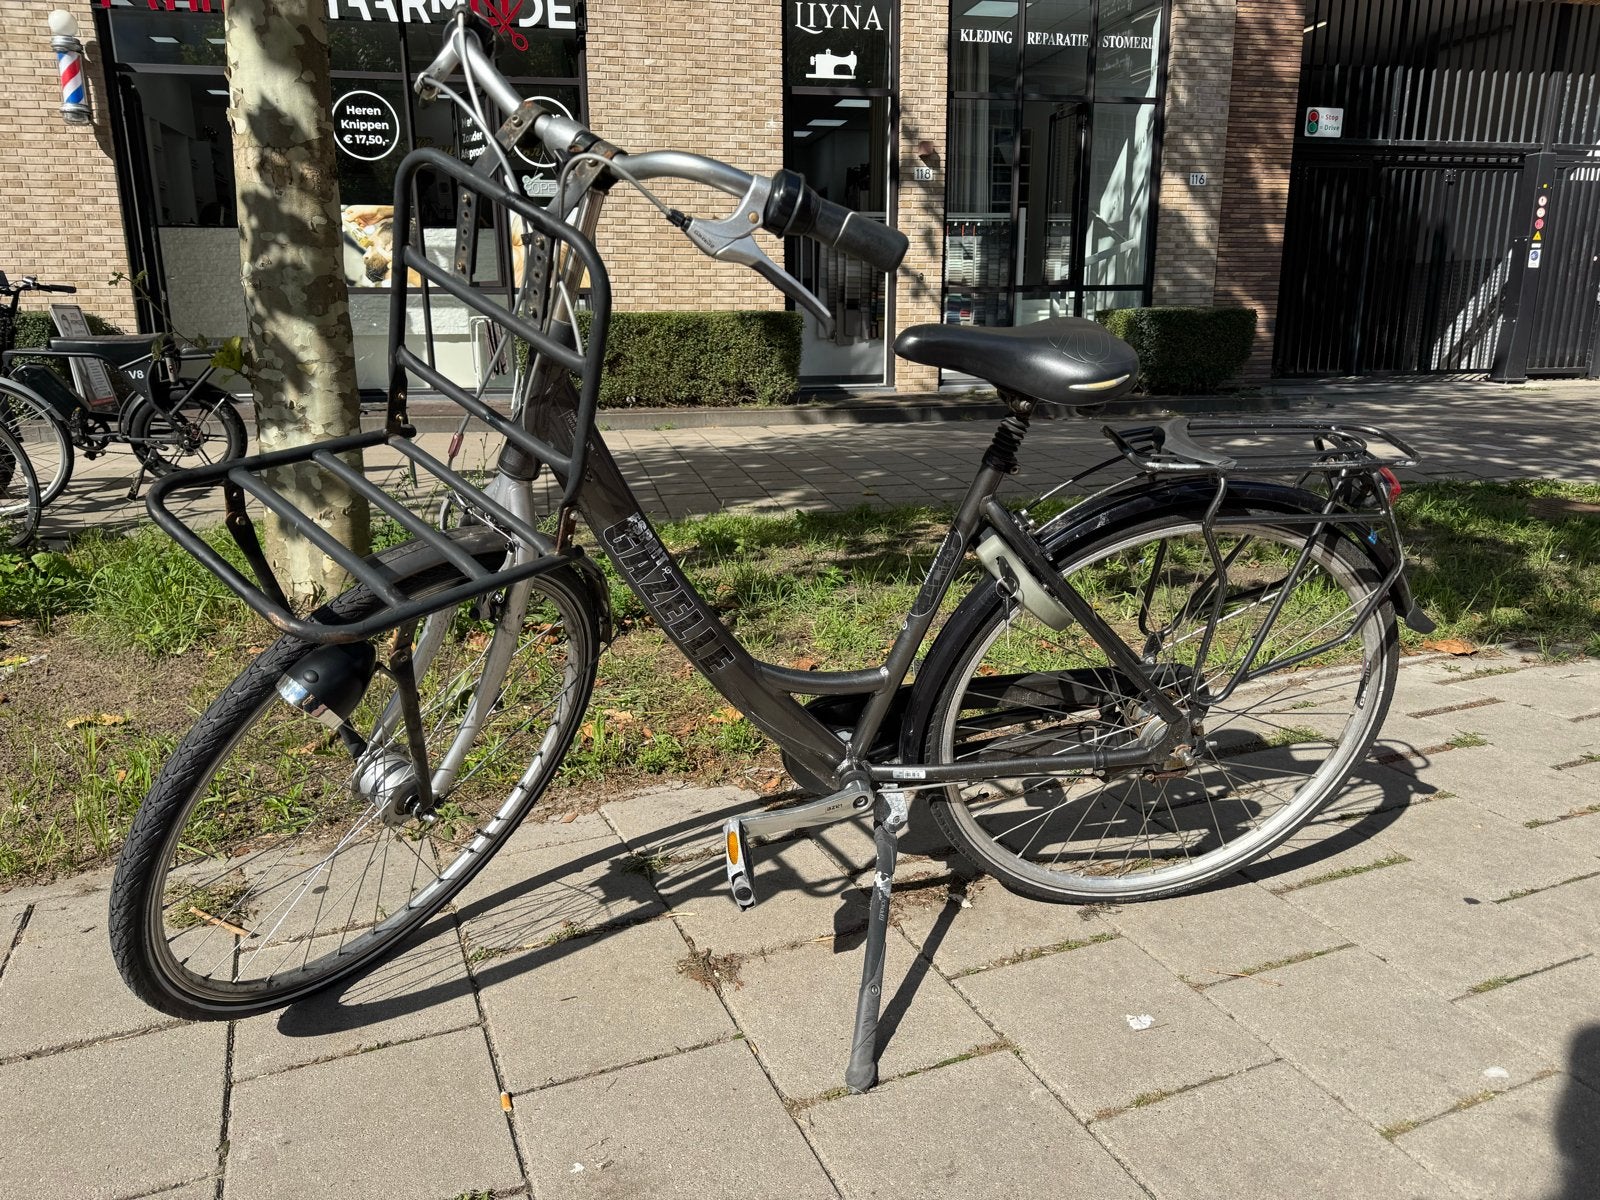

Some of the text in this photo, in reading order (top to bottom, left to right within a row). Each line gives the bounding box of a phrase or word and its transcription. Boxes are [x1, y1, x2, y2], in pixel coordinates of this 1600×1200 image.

[795, 2, 884, 34] LIYNA
[960, 29, 1013, 44] KLEDING
[1027, 31, 1089, 47] REPARATIE
[346, 105, 381, 115] Heren
[341, 119, 389, 131] Knippen
[916, 168, 931, 180] 118
[1191, 174, 1205, 185] 116
[531, 181, 559, 195] OPE
[128, 369, 144, 379] V8
[603, 517, 736, 675] GAZELLE
